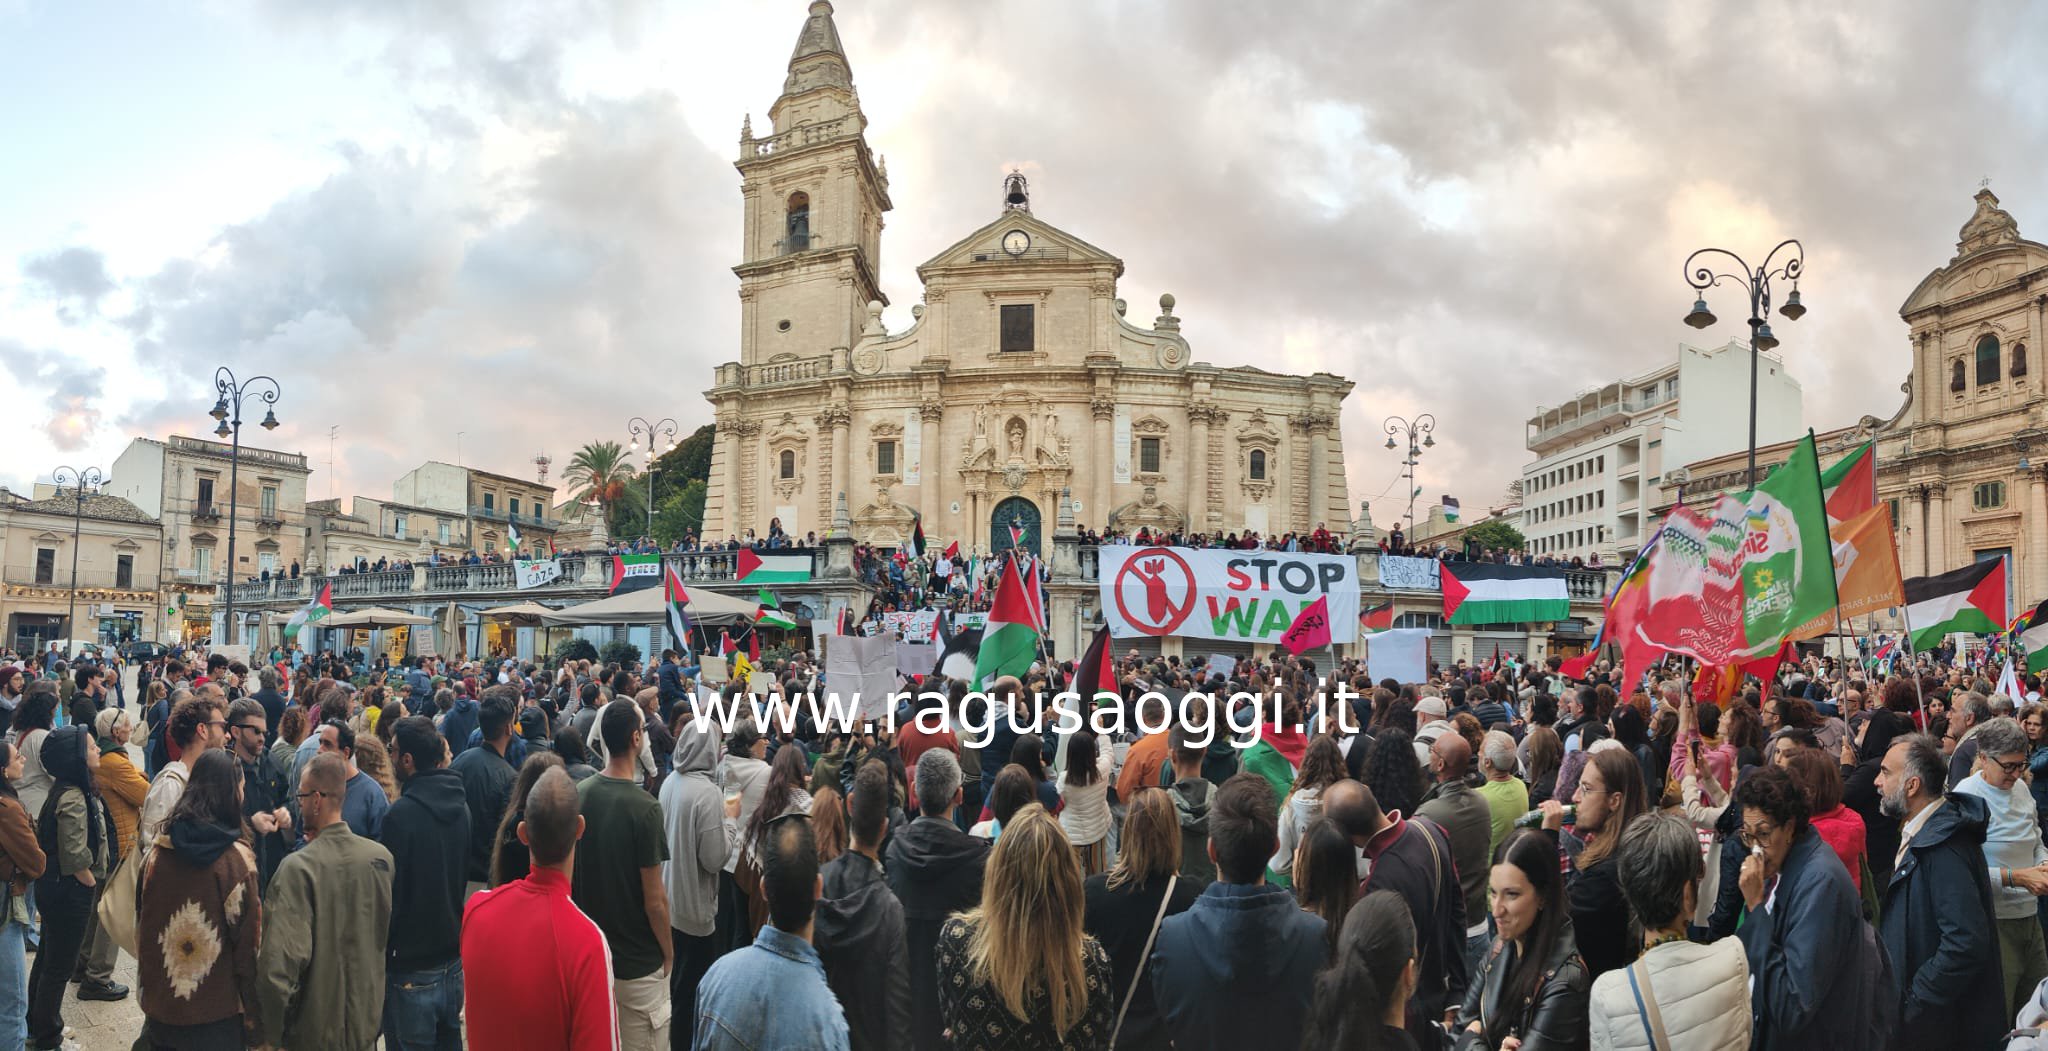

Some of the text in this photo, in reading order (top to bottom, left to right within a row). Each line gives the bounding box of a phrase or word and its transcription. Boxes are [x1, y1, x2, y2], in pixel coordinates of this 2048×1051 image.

[527, 567, 553, 585] GAZA
[1227, 559, 1345, 595] STOP
[1206, 596, 1316, 638] WA
